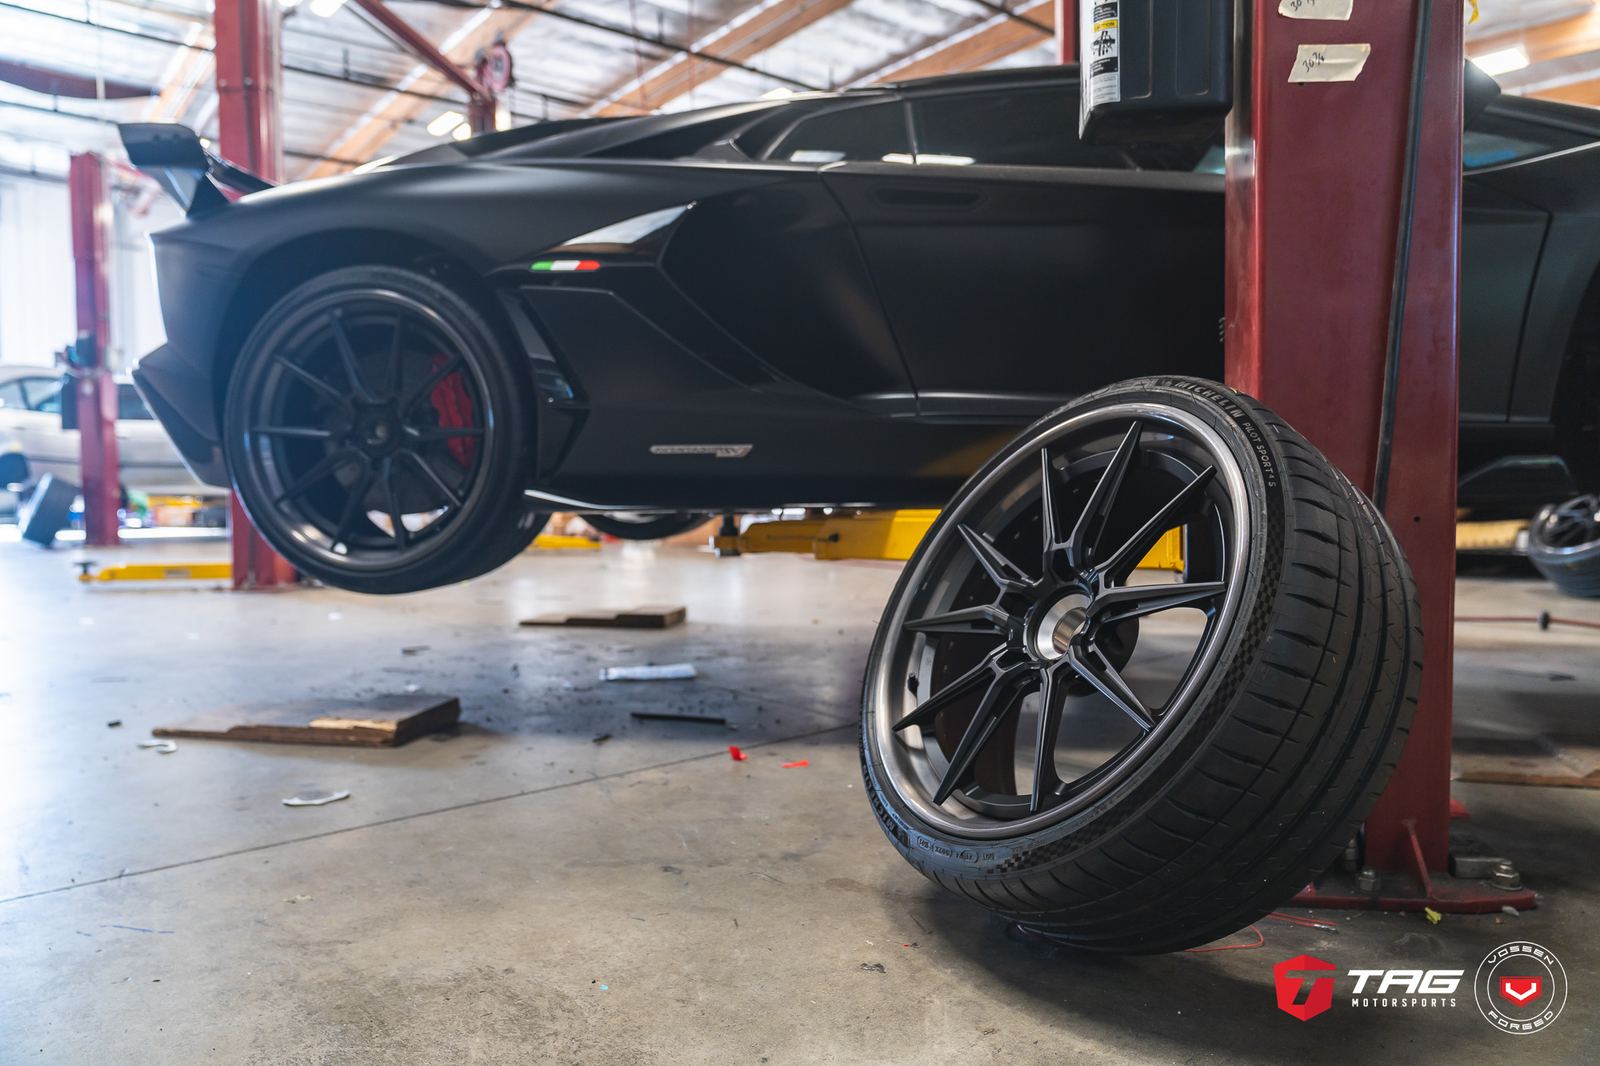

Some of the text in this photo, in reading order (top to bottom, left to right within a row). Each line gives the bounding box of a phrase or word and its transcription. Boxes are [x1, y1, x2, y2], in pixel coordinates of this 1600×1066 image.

[1174, 381, 1244, 418] MICHELIN
[1242, 422, 1261, 442] PILOT
[1256, 444, 1274, 472] SPORT
